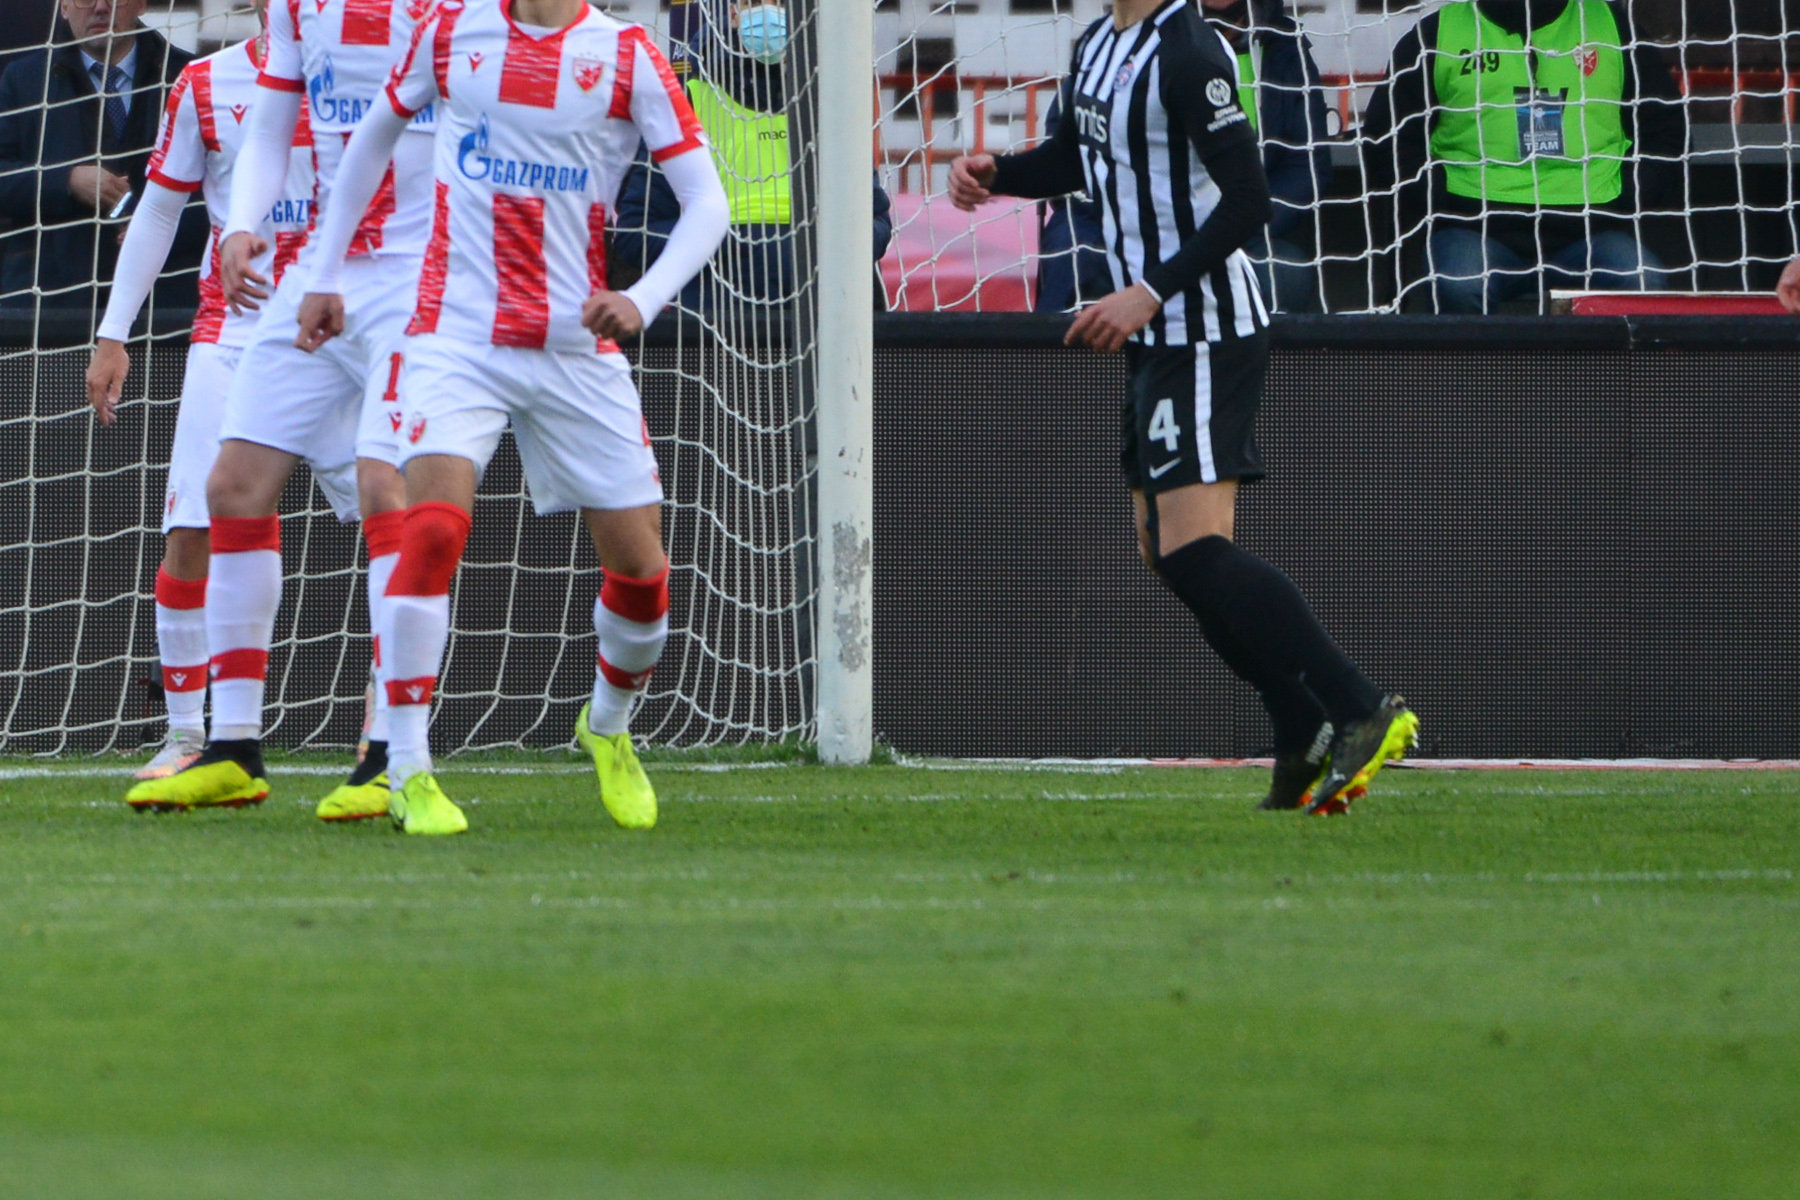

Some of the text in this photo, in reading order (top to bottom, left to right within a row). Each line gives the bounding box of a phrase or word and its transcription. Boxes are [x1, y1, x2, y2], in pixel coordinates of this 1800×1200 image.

[1459, 49, 1500, 76] 249
[1525, 141, 1559, 152] TEAM
[492, 158, 588, 192] GAZPROM
[1148, 398, 1181, 452] 4
